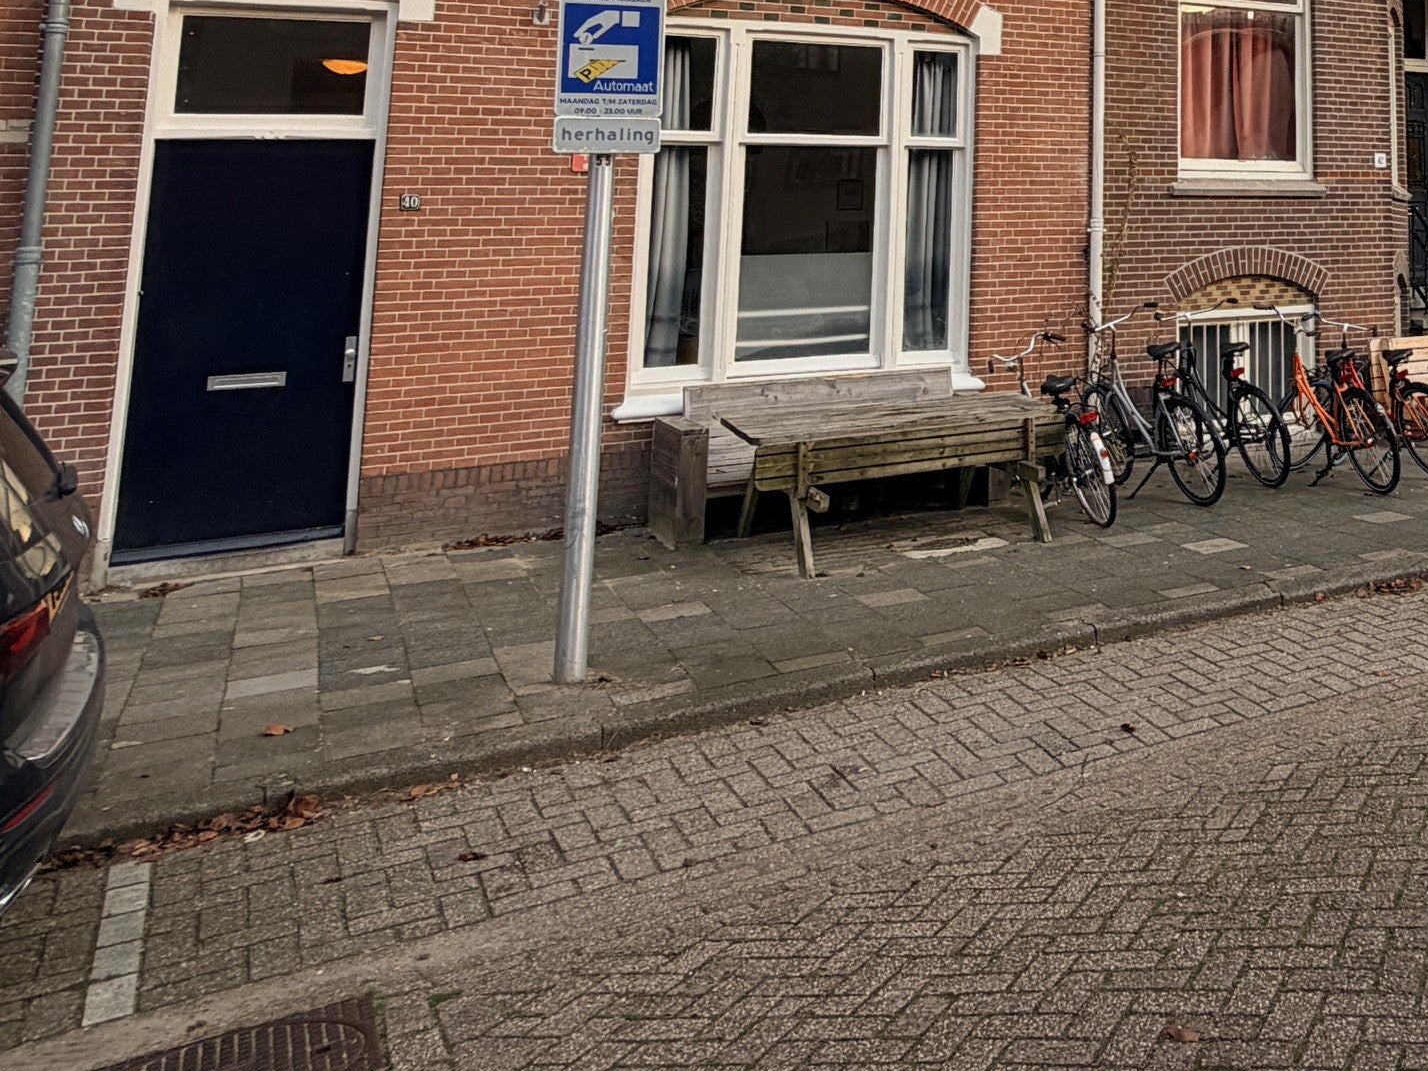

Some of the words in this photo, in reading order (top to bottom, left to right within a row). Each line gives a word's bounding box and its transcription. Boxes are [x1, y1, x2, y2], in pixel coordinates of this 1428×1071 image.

[593, 80, 654, 92] Automaat
[617, 98, 658, 106] ZATERDAG
[562, 128, 655, 145] herhaling
[401, 196, 419, 208] 40
